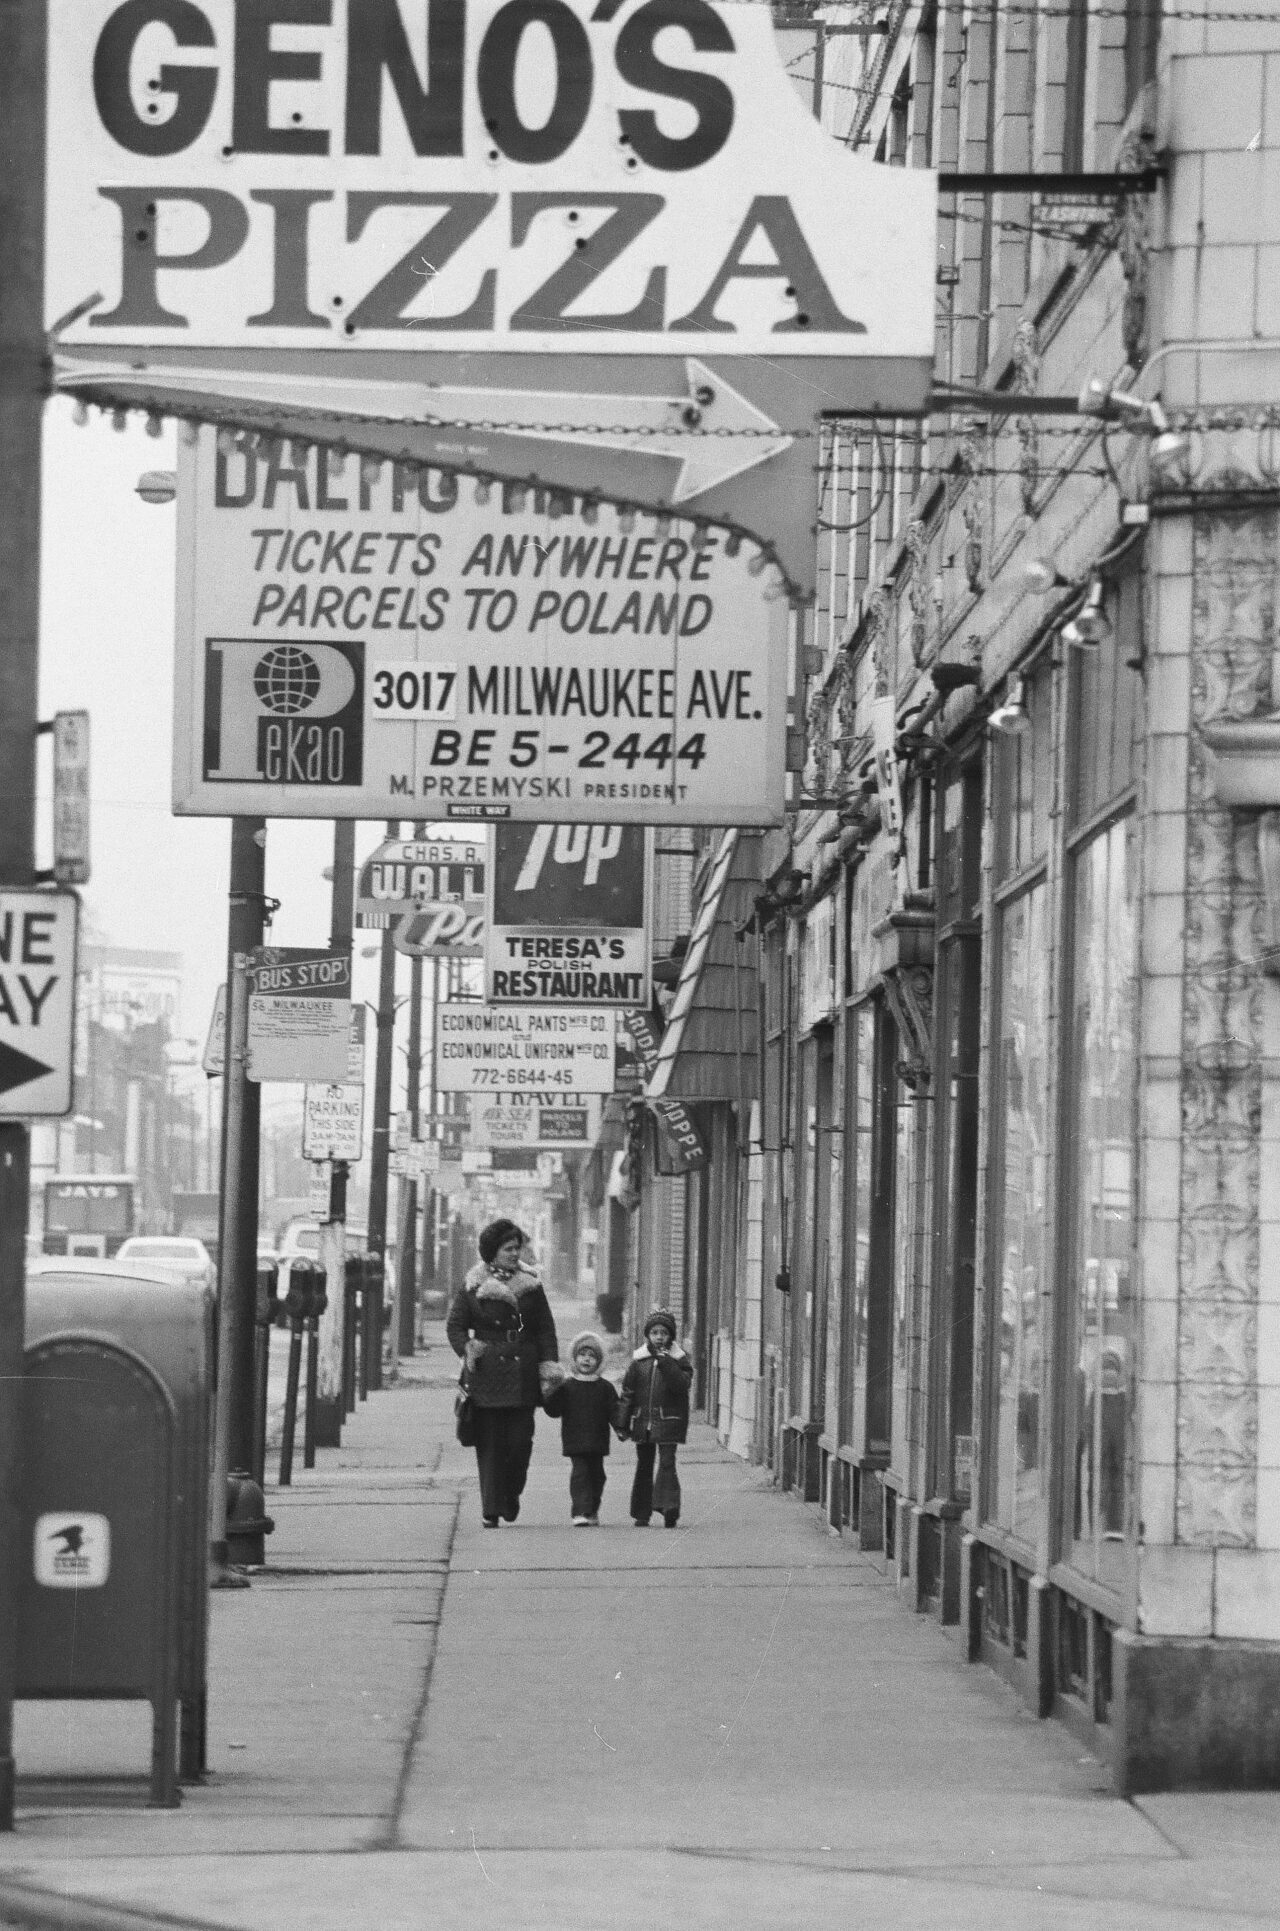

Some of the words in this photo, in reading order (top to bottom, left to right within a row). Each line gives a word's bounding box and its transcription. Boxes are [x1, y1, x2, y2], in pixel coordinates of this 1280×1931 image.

[89, 186, 868, 334] PIZZA
[250, 528, 442, 576] TICKETS
[461, 532, 719, 581] ANYWHERE
[252, 583, 450, 631] PARCELS
[463, 587, 518, 632] TO
[528, 589, 714, 637] POLAND
[373, 671, 456, 711] 3017
[467, 665, 675, 719] MILWAUKEE
[686, 669, 763, 720] AVE.
[430, 729, 496, 766] BE
[390, 775, 414, 796] M.
[422, 776, 571, 798] PRZEMYSKI
[584, 784, 688, 800] PRESIDENT
[485, 806, 508, 815] WAY
[402, 845, 459, 861] CHAS.
[505, 936, 625, 960] TERESA'S
[259, 968, 292, 990] BUS
[297, 961, 343, 985] STOP
[528, 959, 592, 970] POLISH
[493, 970, 643, 999] RESTAURANT
[442, 1014, 523, 1032] ECONOMICAL
[528, 1015, 567, 1032] PANTS
[442, 1042, 521, 1060] ECONOMICAL
[525, 1043, 575, 1060] UNIFORM
[472, 1068, 573, 1085] 772-6644-45
[309, 1101, 360, 1116] PARKING
[662, 1101, 703, 1161] OPPE
